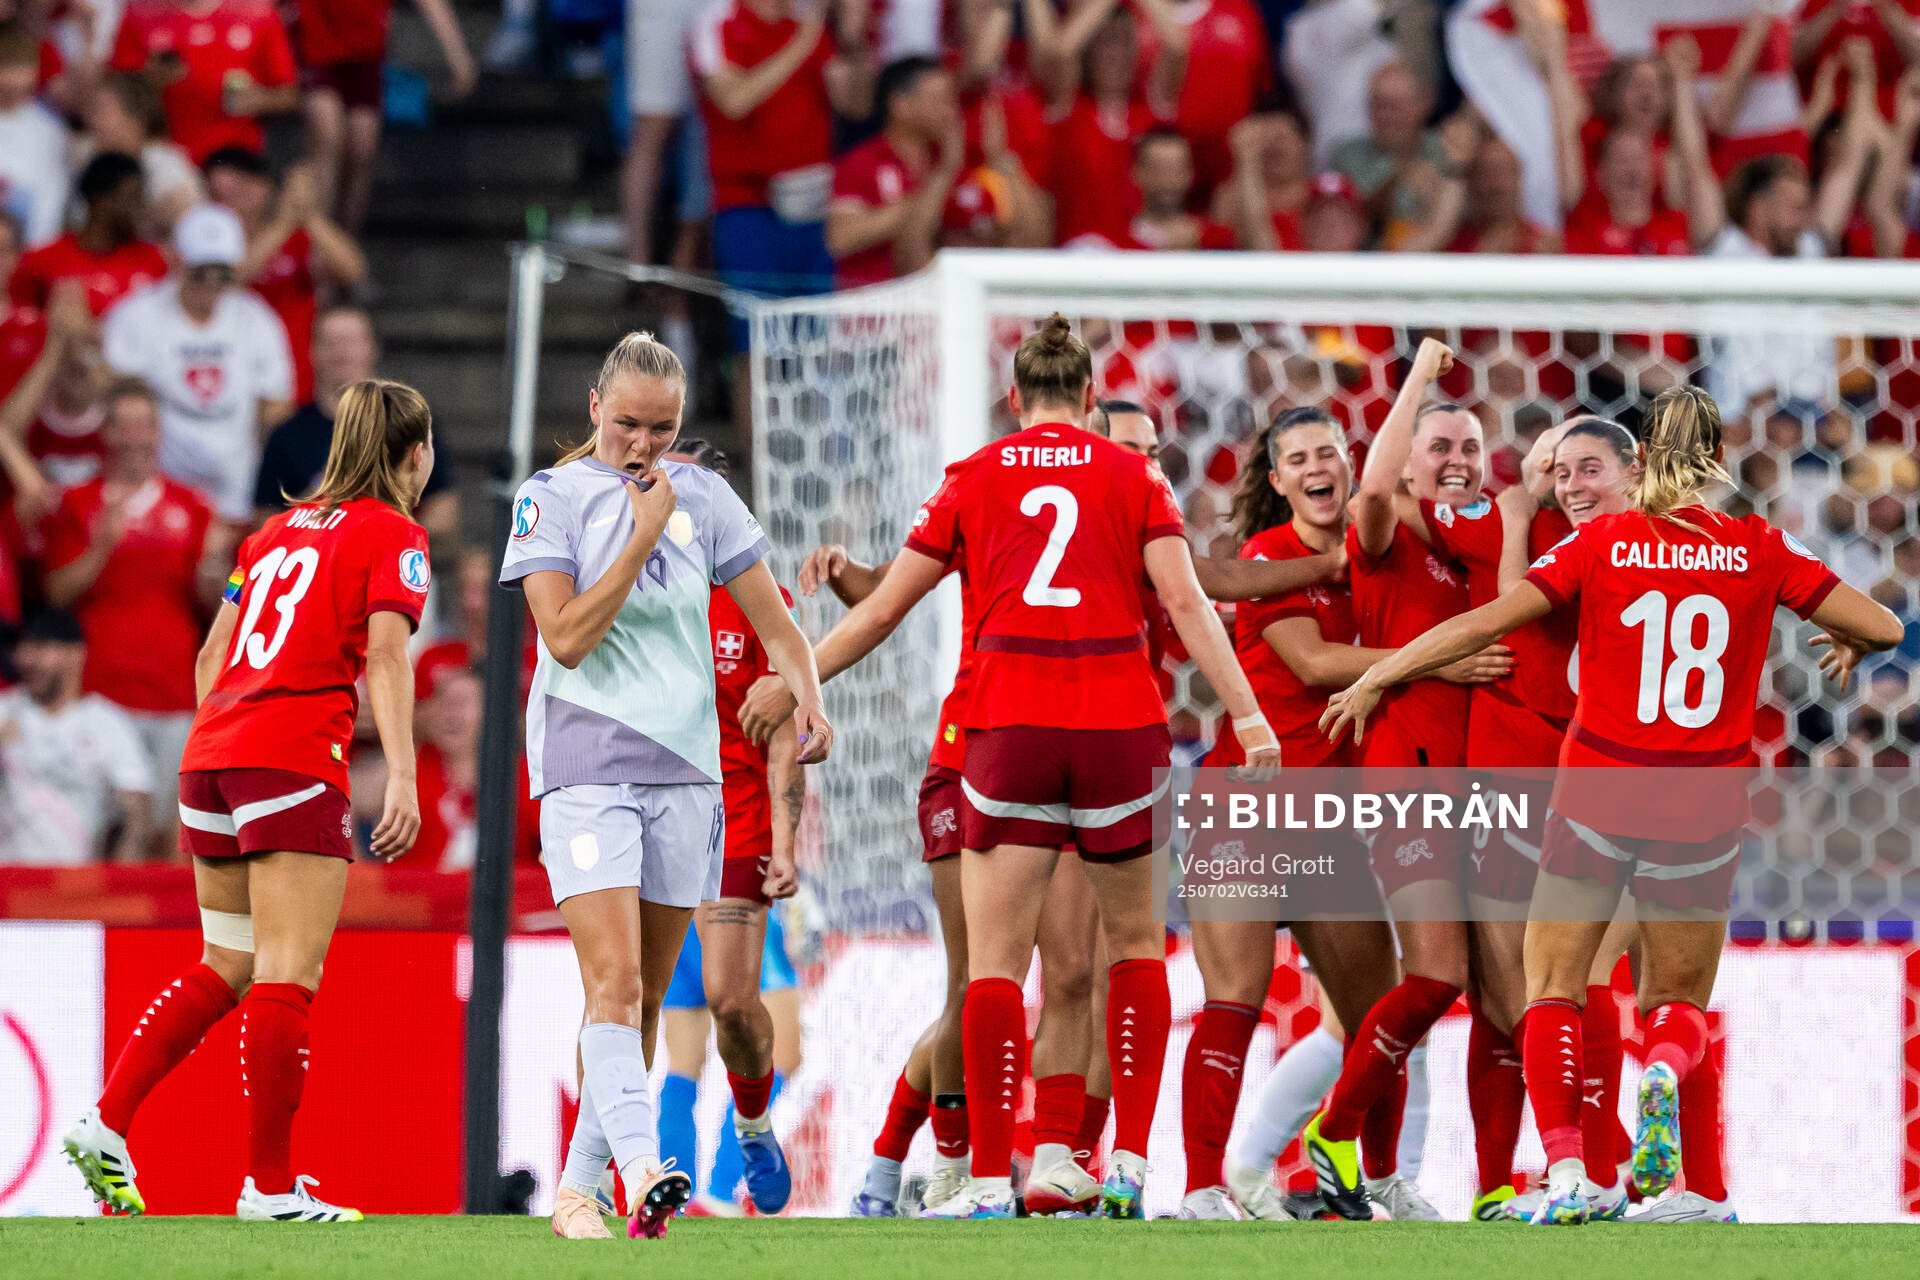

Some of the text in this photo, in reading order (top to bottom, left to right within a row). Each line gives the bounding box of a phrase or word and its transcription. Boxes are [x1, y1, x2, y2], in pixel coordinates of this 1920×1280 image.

[1000, 444, 1092, 467] STIERLI
[231, 546, 320, 670] 13
[1019, 485, 1082, 608] 2
[1611, 540, 1749, 573] CALLIGARIS
[1619, 589, 1731, 729] 18
